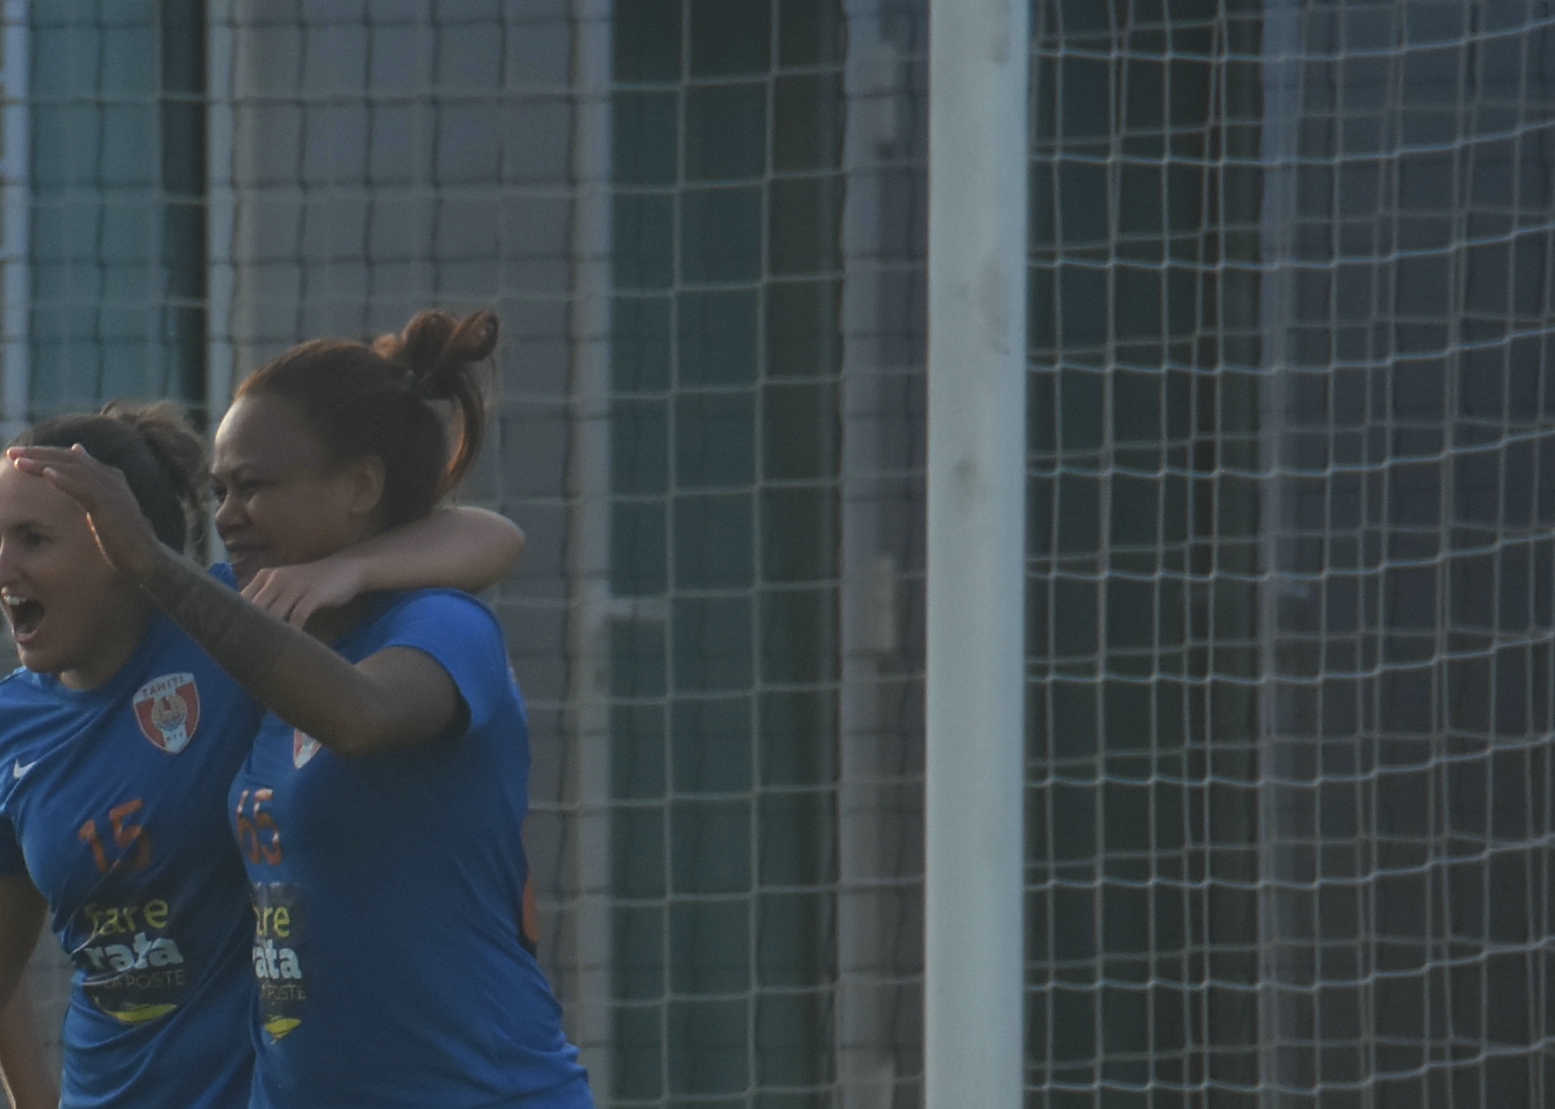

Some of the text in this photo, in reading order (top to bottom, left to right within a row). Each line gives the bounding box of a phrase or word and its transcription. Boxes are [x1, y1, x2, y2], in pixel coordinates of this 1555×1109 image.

[78, 798, 152, 872] 15
[85, 931, 184, 972] rata
[252, 938, 302, 979] ata
